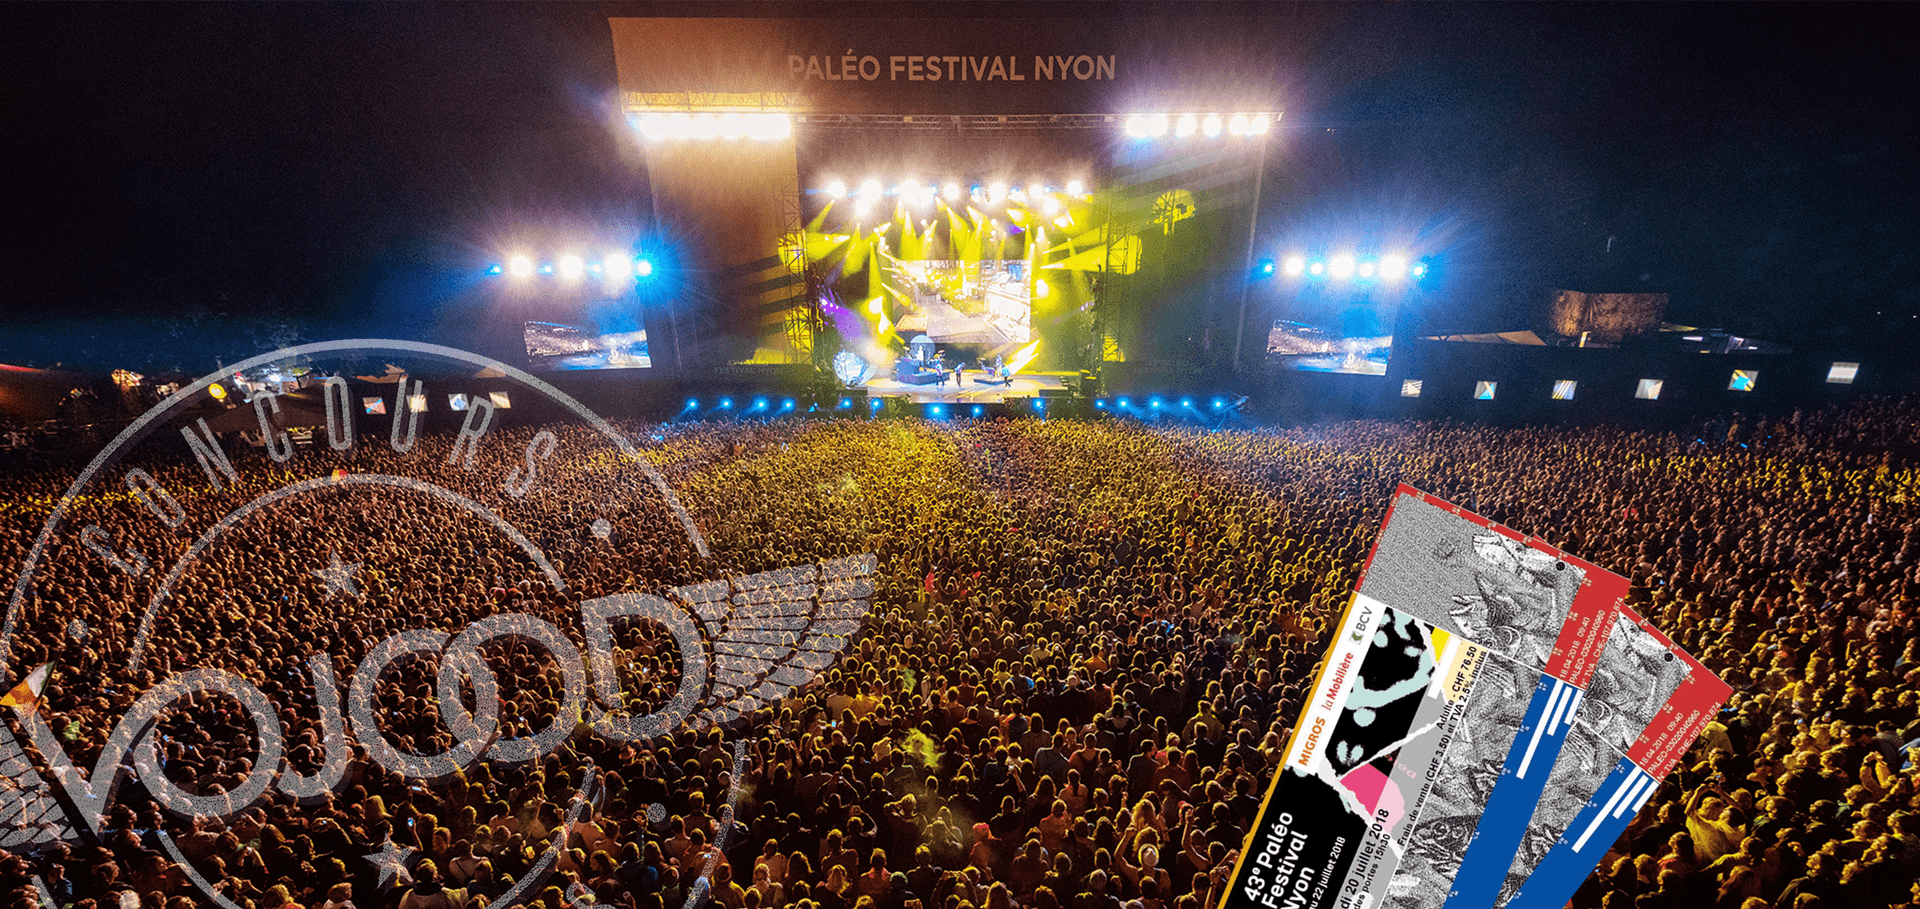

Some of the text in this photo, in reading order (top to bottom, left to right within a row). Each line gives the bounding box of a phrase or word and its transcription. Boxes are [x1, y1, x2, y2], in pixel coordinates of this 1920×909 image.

[787, 48, 1116, 81] PALÉO FESTIVAL NYON
